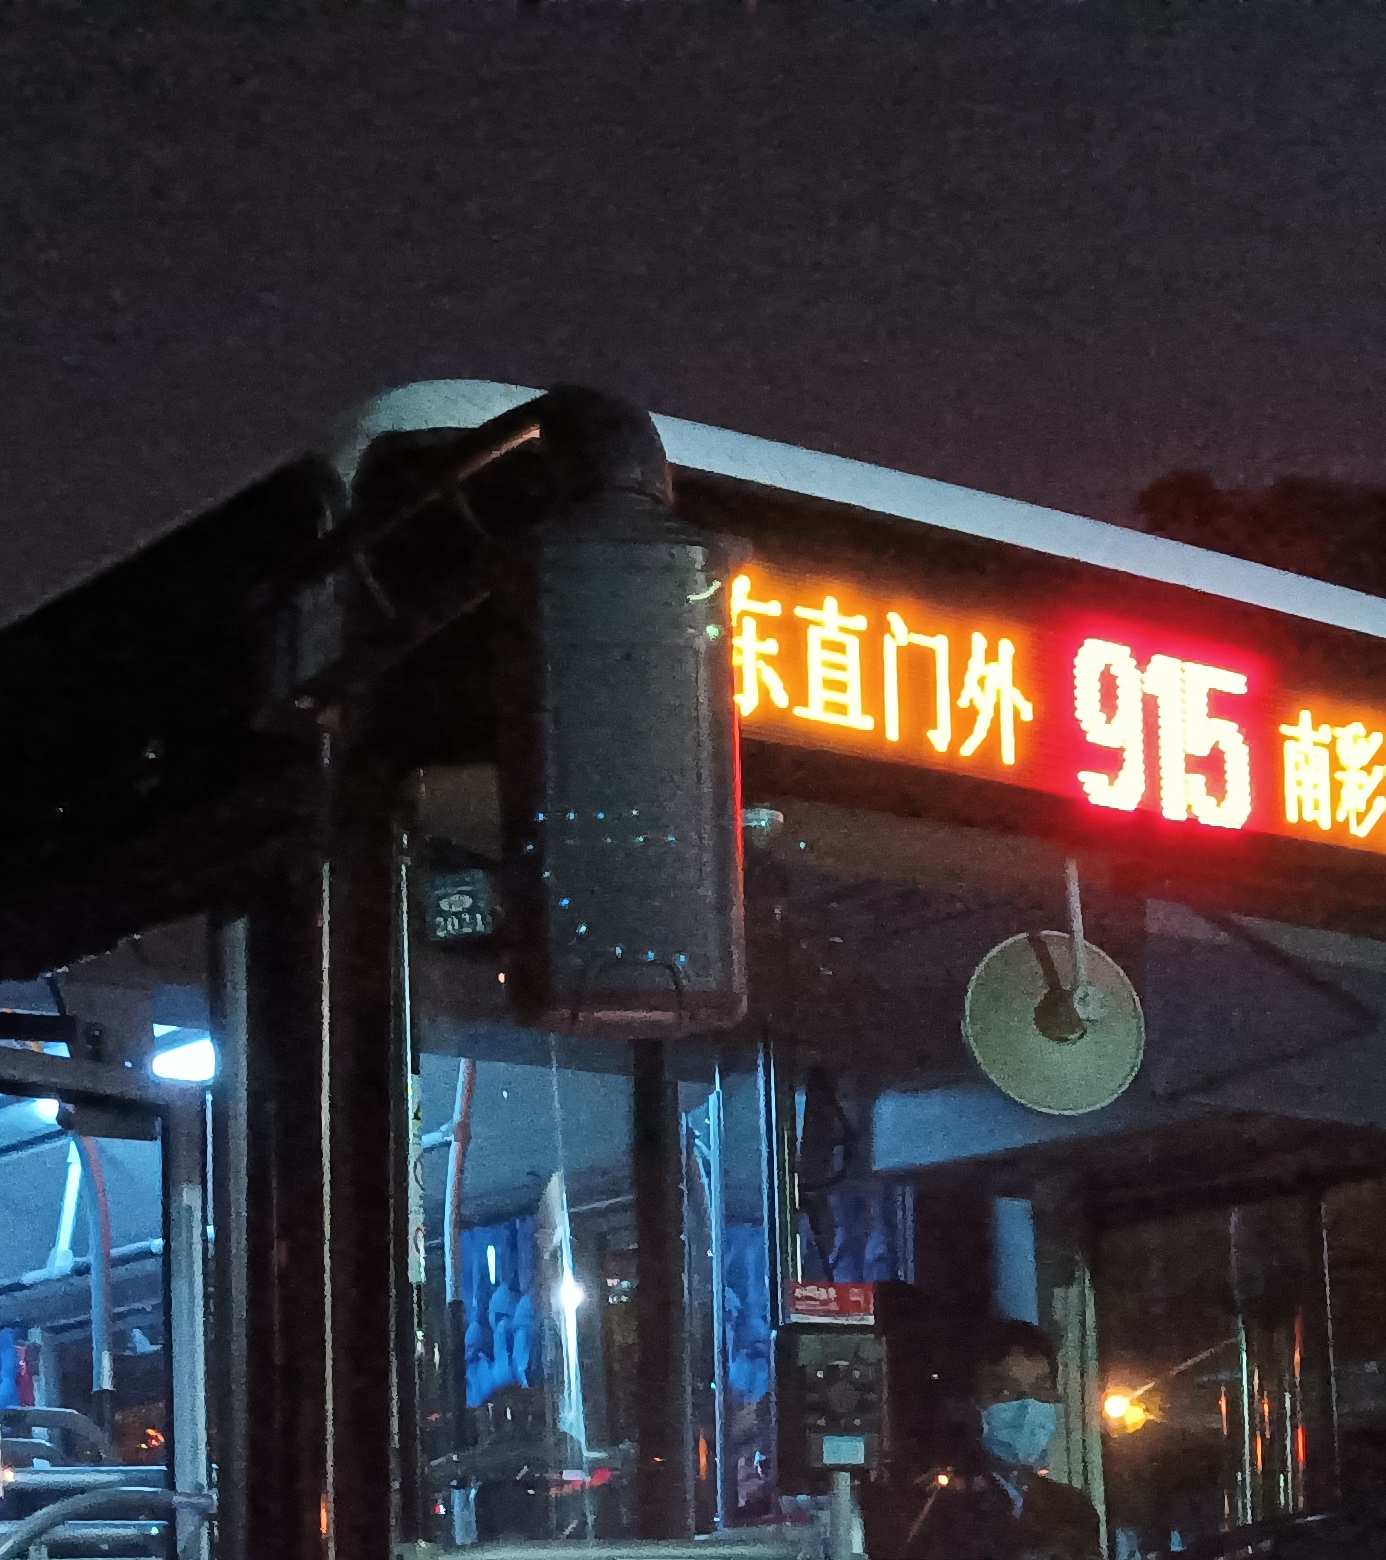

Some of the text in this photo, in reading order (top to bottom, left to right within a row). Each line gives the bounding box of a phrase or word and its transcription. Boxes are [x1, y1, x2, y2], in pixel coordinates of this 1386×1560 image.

[730, 573, 1034, 766] 东直门外
[1073, 637, 1253, 830] 915
